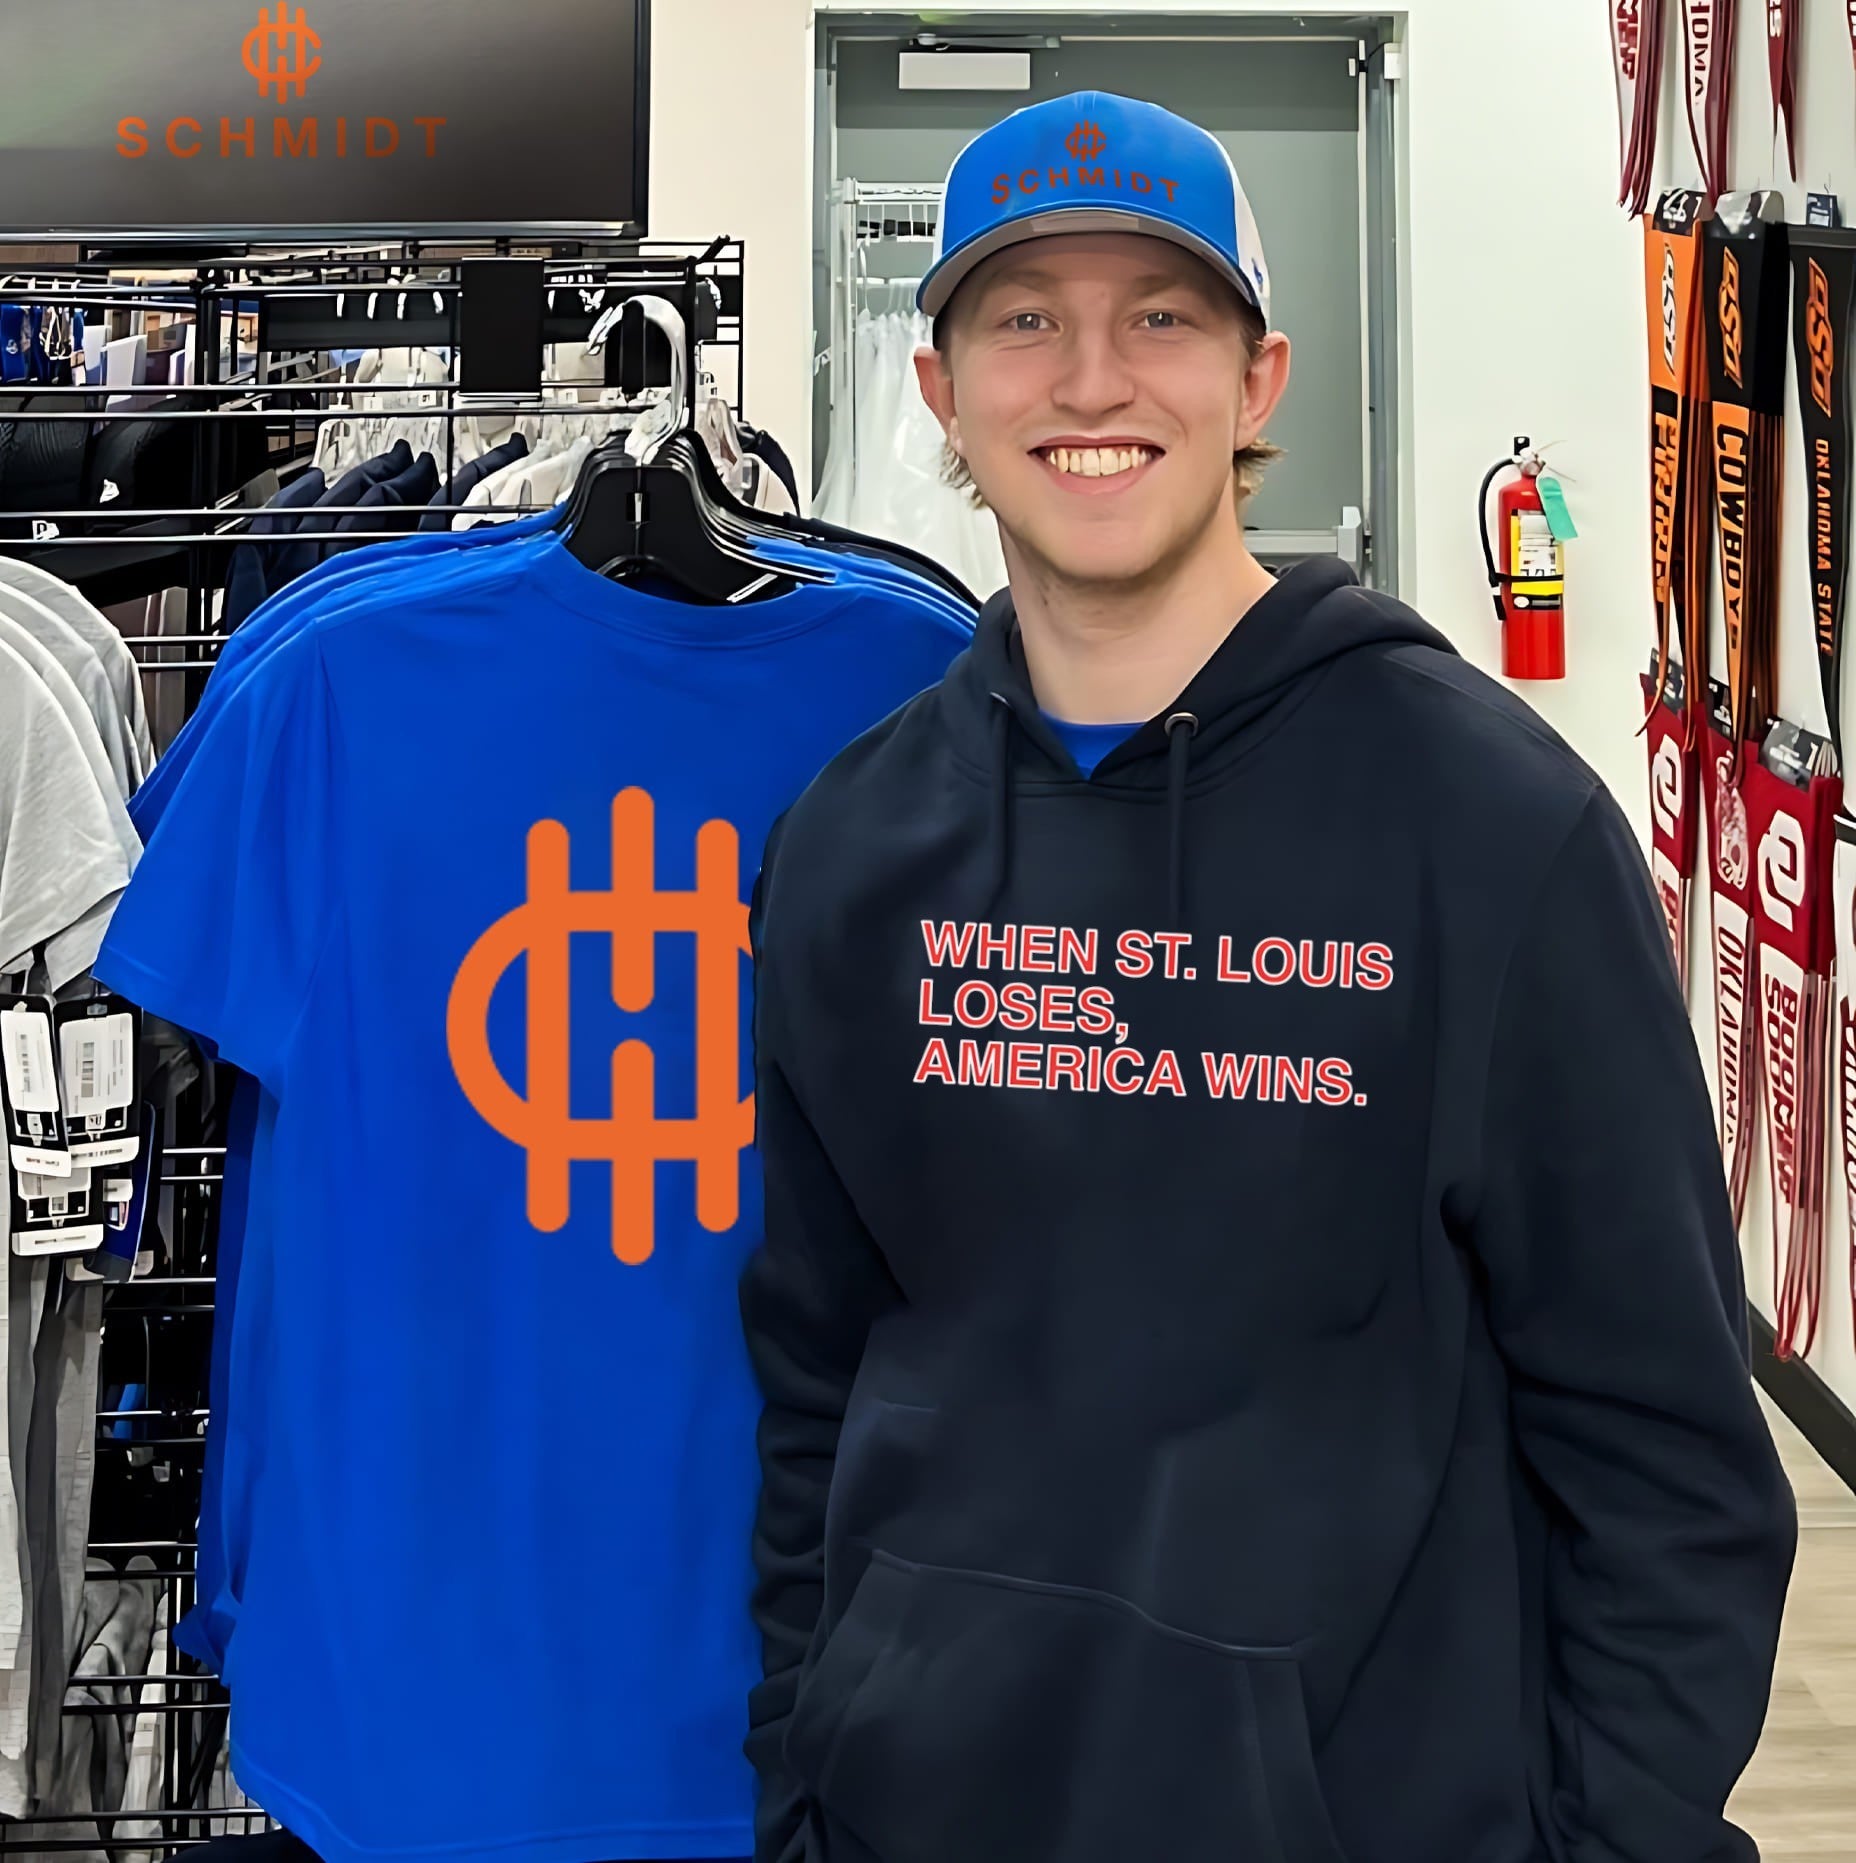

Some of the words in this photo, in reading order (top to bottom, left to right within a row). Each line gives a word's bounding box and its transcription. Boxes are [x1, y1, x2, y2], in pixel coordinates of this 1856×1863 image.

[1690, 0, 1710, 97] OMA
[116, 116, 448, 159] SCHMIDT
[991, 167, 1179, 205] SCHMIDT
[1815, 438, 1832, 570] OKLAHOMA
[1817, 582, 1834, 656] STATE
[920, 920, 1099, 975] WHEN
[1114, 930, 1198, 980] ST.
[1216, 935, 1395, 990] LOUIS
[918, 978, 1130, 1044] LOSES,
[913, 1038, 1187, 1097] AMERICA
[1201, 1051, 1368, 1107] WINS.
